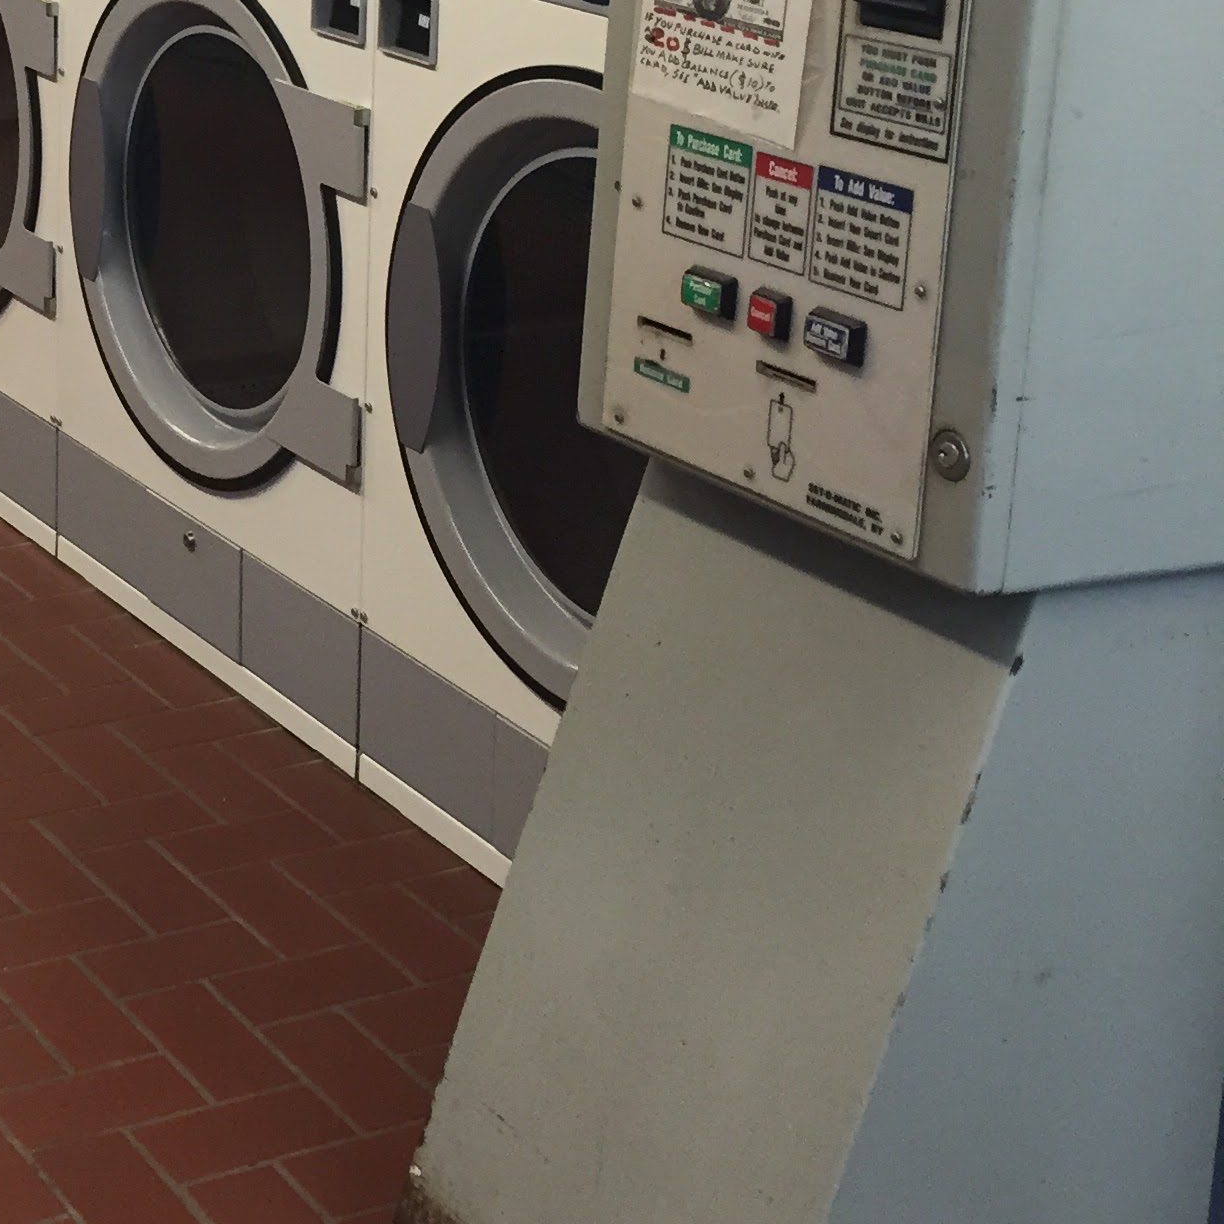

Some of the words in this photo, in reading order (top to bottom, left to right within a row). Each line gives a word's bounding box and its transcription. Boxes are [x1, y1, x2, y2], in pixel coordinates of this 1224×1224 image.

[655, 17, 672, 30] YOU
[674, 22, 722, 45] PURCHASE
[735, 44, 760, 55] CARD
[658, 50, 680, 65] ADD
[693, 44, 714, 57] BILL
[716, 50, 744, 65] MAKE
[747, 58, 774, 74] SURE
[675, 130, 684, 145] To
[687, 134, 719, 156] Purchase
[833, 174, 844, 191] To
[847, 178, 864, 197] Add
